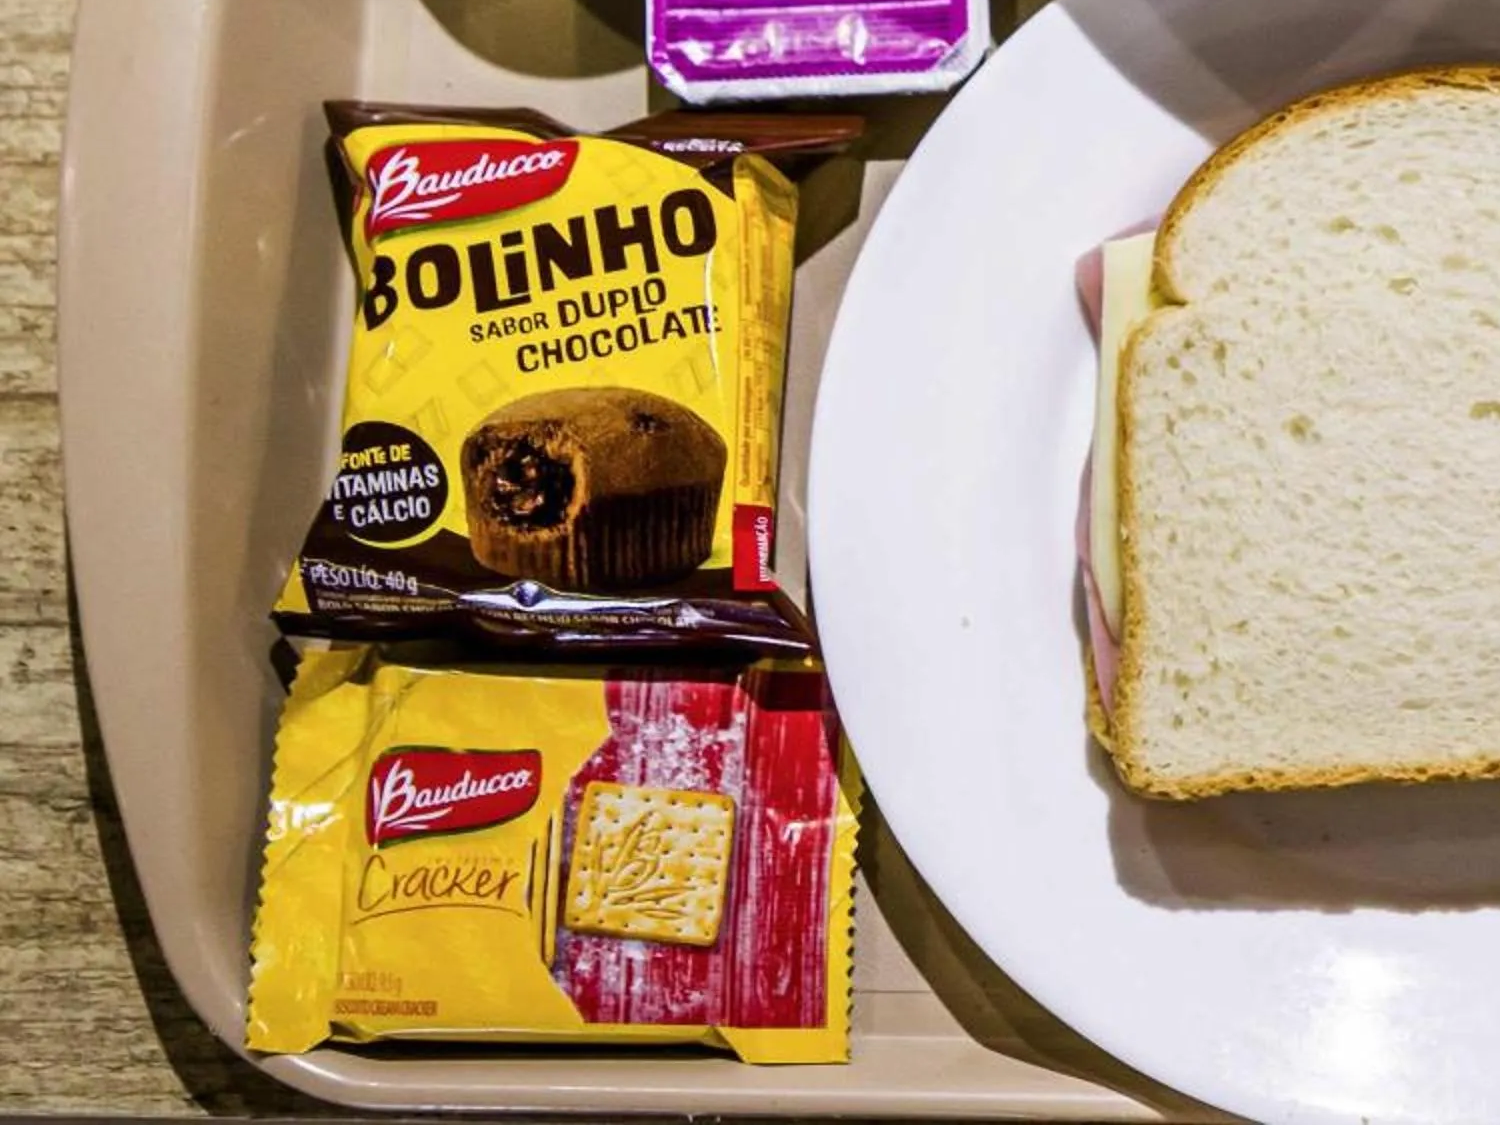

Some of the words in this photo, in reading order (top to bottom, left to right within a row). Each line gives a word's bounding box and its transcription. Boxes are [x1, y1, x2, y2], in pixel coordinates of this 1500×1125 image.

[370, 148, 566, 224] Bauducco
[469, 312, 550, 343] SABOR
[557, 277, 668, 328] DUPLO
[516, 303, 724, 373] CHOCOLATE
[341, 446, 387, 470] FONTE
[389, 443, 412, 462] DE
[333, 504, 345, 520] E
[351, 495, 431, 528] CÁLCIO
[310, 563, 350, 586] PESO
[372, 759, 533, 830] Bauducco
[357, 854, 520, 911] Cracker
